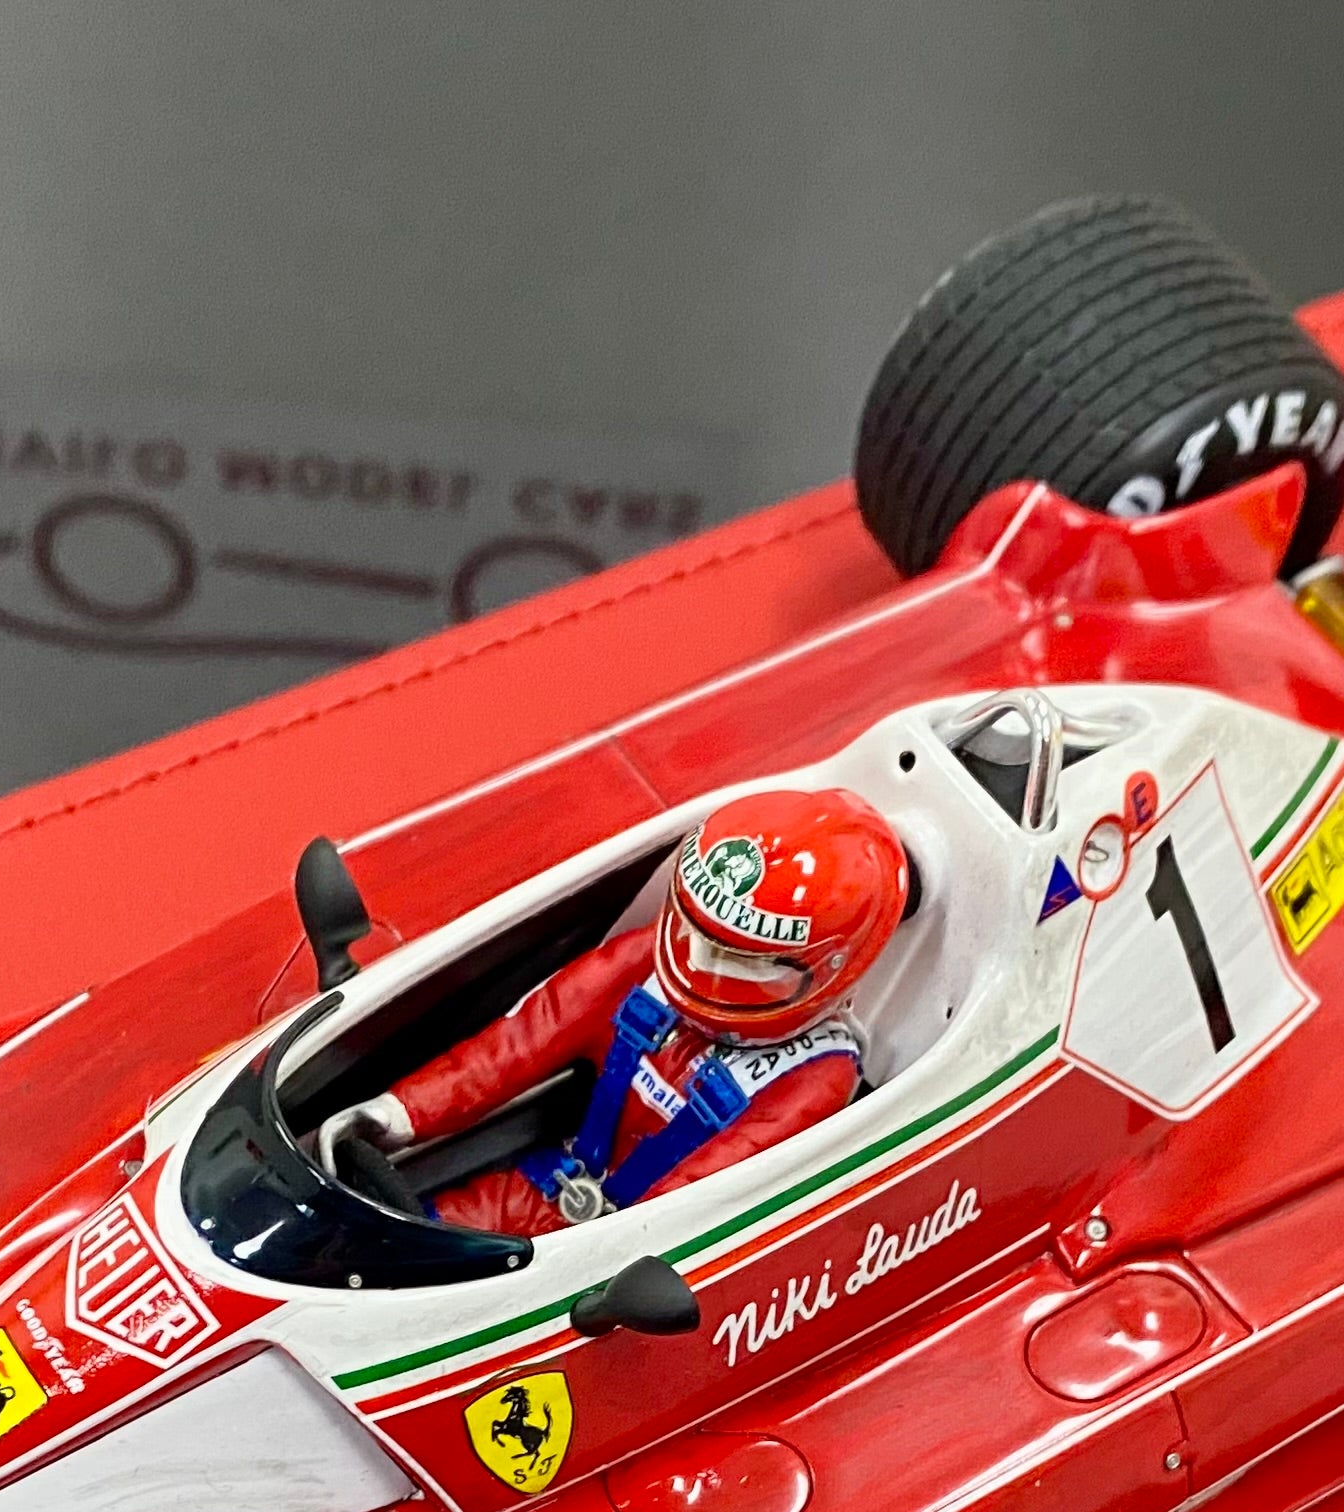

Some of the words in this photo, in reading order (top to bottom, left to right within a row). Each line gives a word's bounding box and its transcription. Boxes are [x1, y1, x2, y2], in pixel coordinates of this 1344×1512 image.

[1145, 834, 1237, 1055] 1
[78, 1207, 200, 1354] HEUER
[712, 1258, 838, 1368] Niki
[844, 1178, 983, 1298] Lauda
